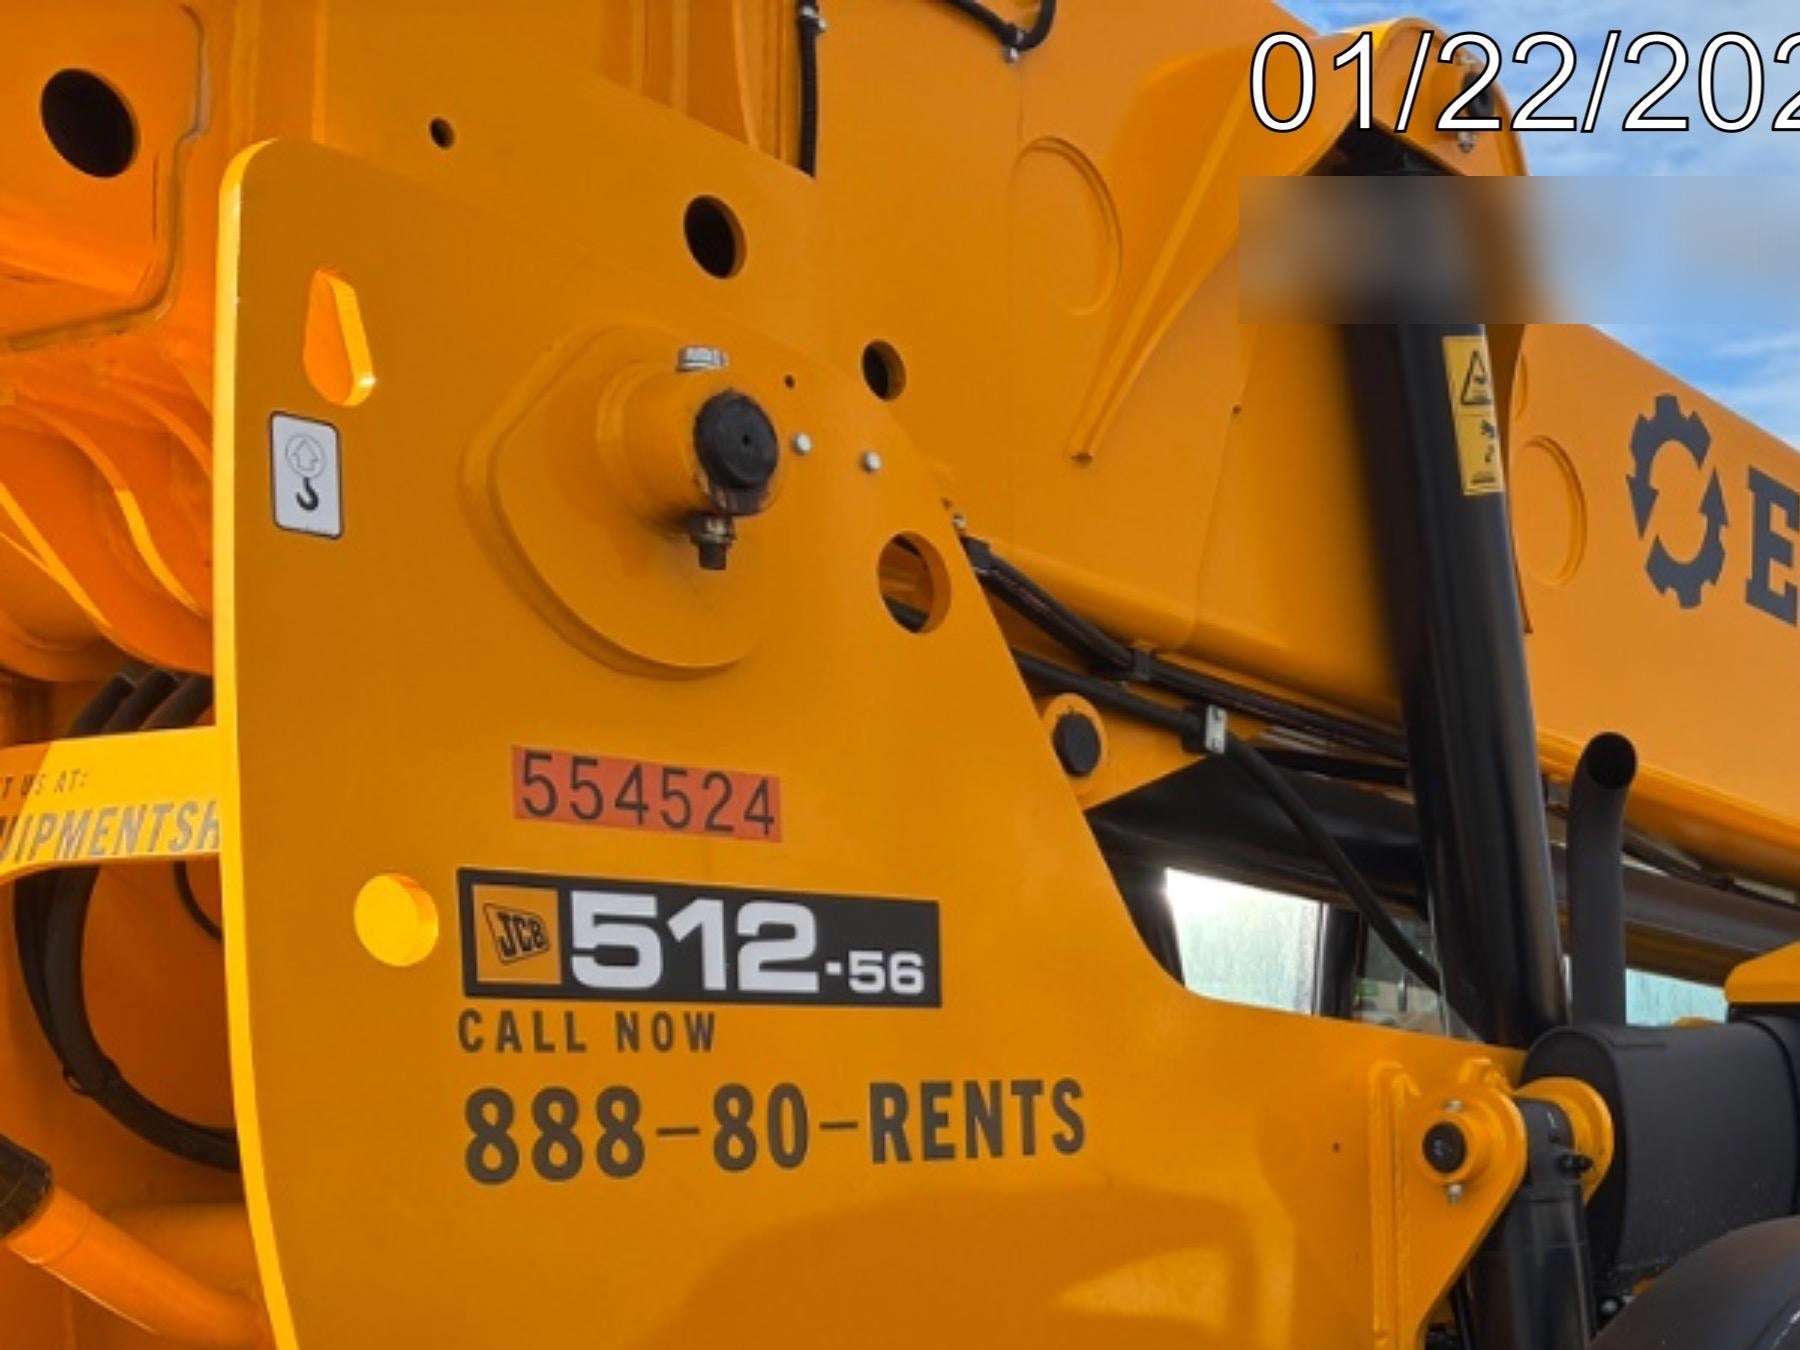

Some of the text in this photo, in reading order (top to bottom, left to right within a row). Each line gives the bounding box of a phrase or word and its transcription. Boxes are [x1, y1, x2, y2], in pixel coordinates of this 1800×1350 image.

[521, 750, 775, 835] 554524
[499, 910, 546, 956] JCB
[458, 1010, 716, 1054] CALL NOW
